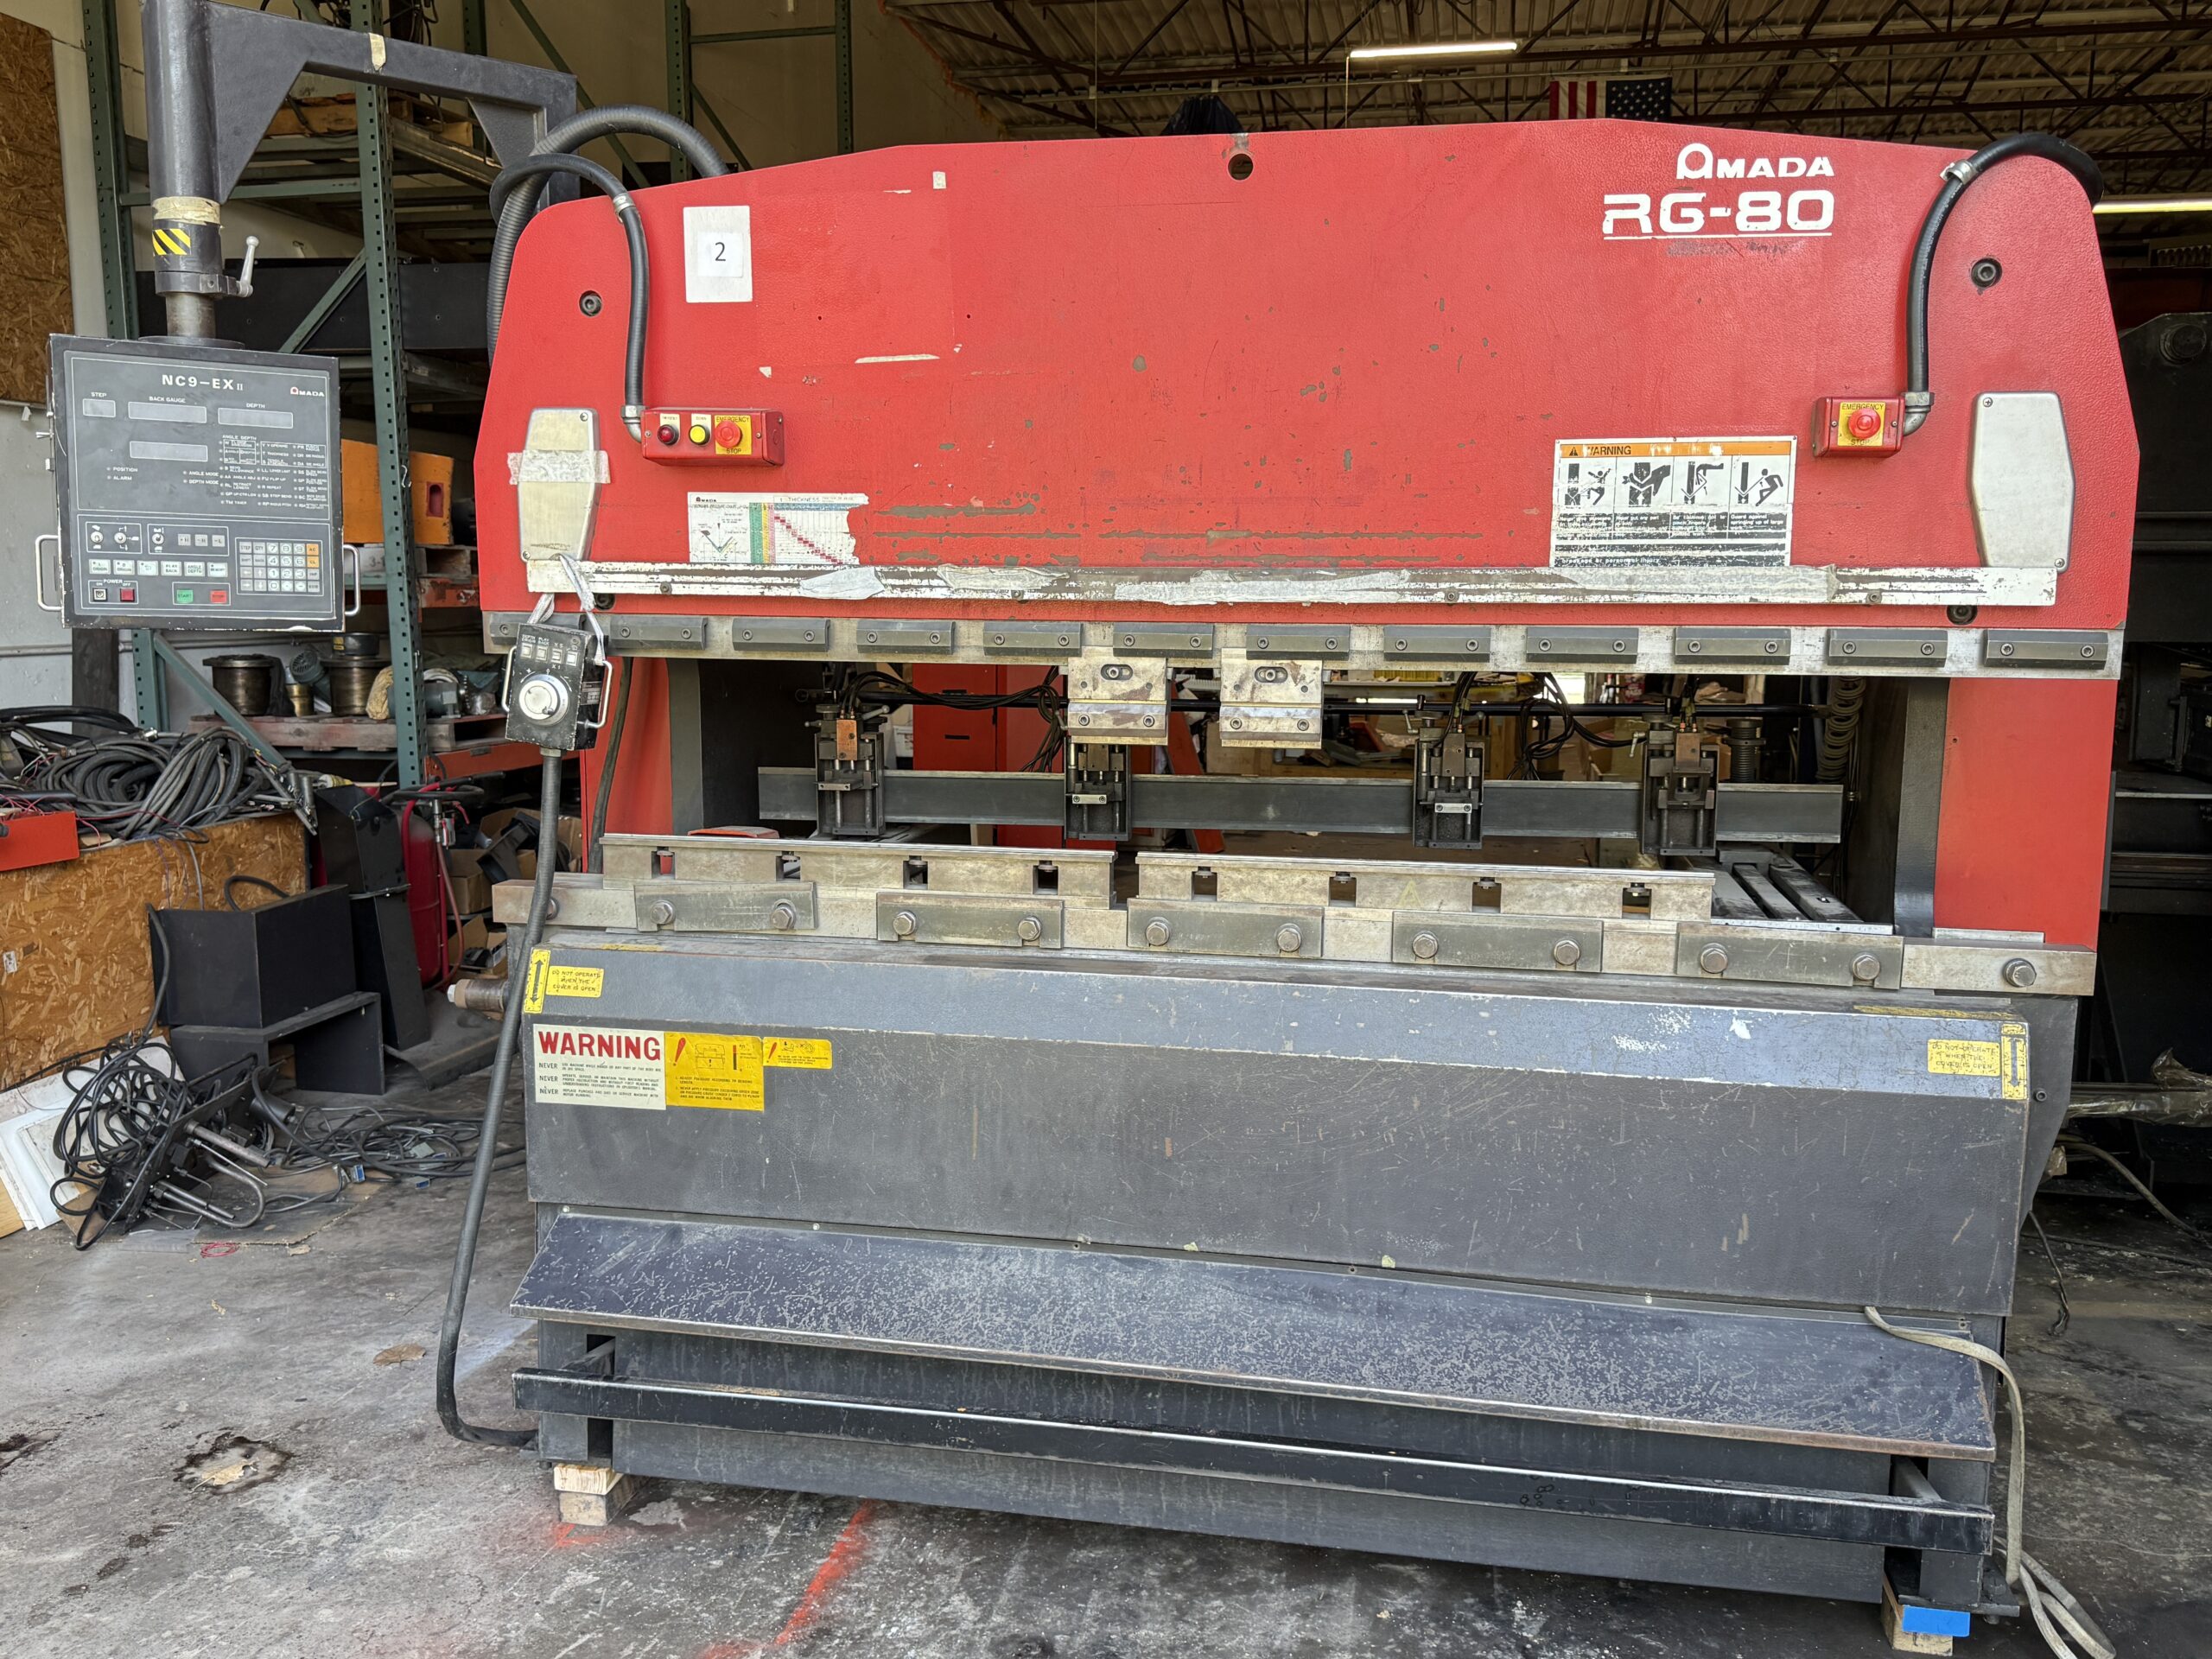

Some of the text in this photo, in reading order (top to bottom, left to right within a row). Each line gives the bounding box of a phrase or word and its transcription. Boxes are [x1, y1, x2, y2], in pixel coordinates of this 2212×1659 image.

[1676, 143, 1834, 179] AMADA
[1602, 189, 1834, 234] RG-80
[715, 242, 726, 261] 2
[290, 386, 325, 397] AMADA
[538, 1031, 661, 1061] WARNING
